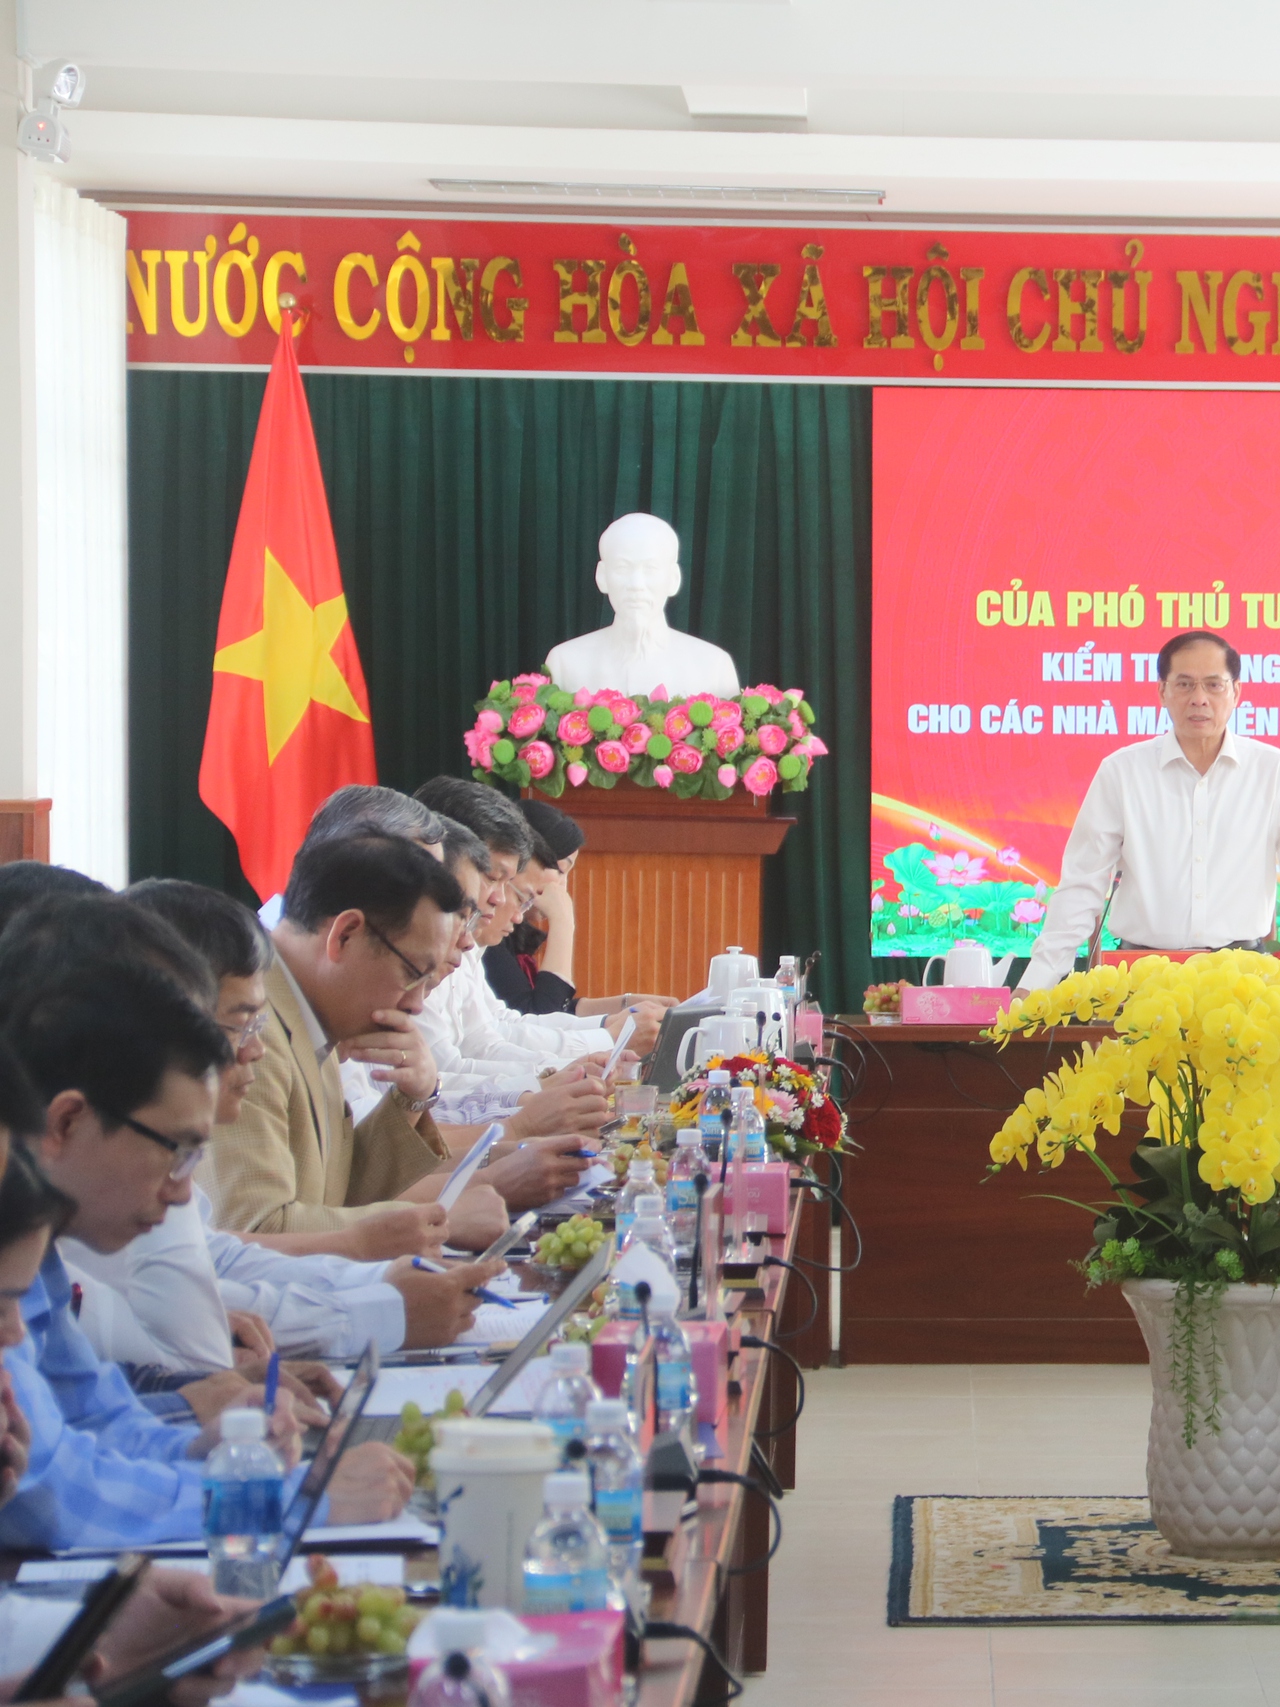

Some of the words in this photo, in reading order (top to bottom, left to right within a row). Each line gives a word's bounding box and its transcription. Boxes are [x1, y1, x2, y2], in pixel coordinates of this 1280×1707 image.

[126, 222, 310, 337] NƯỚC
[334, 230, 529, 364] CỘNG
[553, 232, 706, 347] HÒA
[730, 243, 839, 348] XÃ
[862, 242, 985, 371] HỘI
[1007, 239, 1153, 354] CHỦ
[976, 579, 1055, 627] CỦA
[1066, 584, 1145, 628] PHÓ
[1156, 580, 1230, 629] THỦ
[1042, 641, 1122, 683] KIỂM
[907, 703, 972, 735] CHO
[980, 699, 1044, 735] CÁC
[1053, 700, 1119, 735] NHÀ
